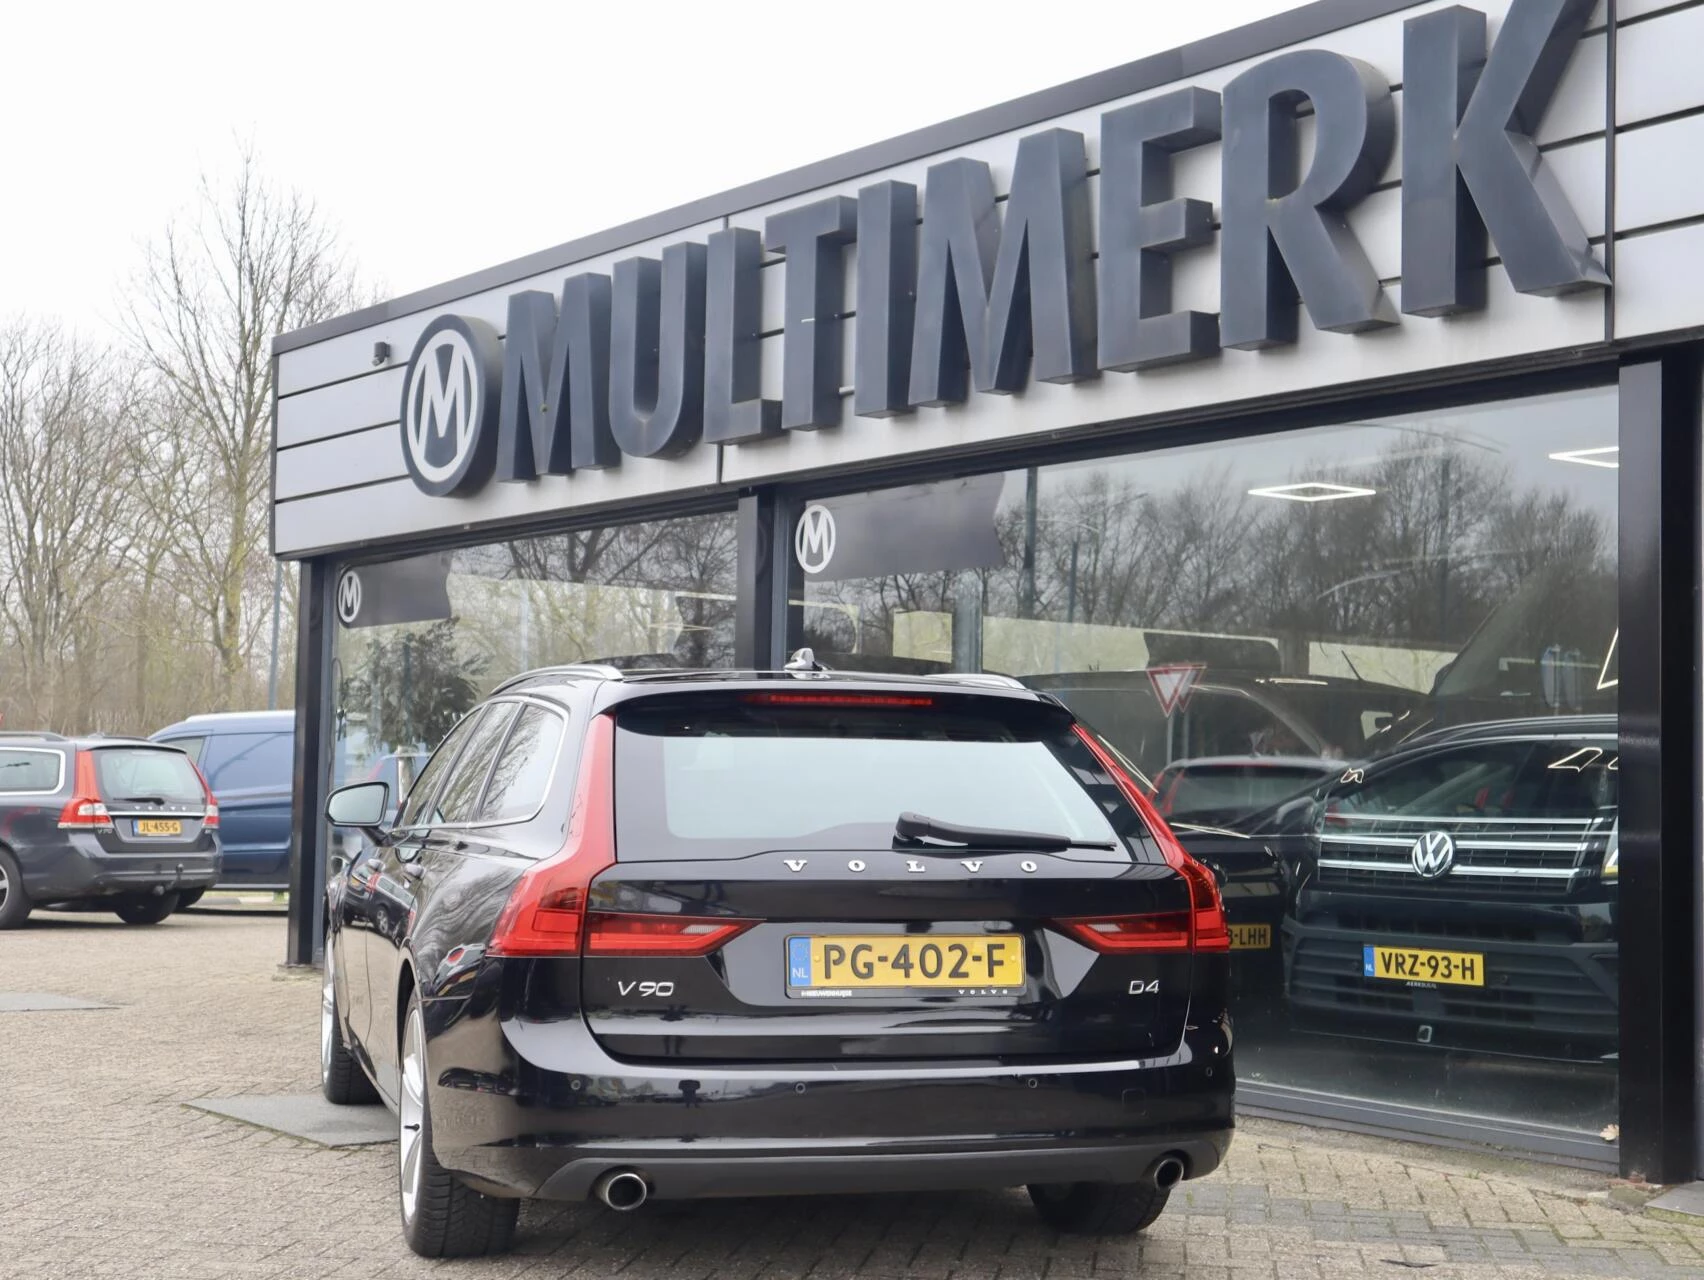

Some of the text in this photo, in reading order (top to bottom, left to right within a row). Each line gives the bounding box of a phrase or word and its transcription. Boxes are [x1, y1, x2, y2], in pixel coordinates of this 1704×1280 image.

[496, 0, 1612, 480] MULTIMERK
[411, 330, 474, 478] M
[797, 507, 834, 571] M
[339, 572, 360, 620] M
[783, 859, 1039, 873] VOLVO
[792, 967, 809, 979] NL
[823, 943, 1006, 980] PG-402-F
[1380, 951, 1476, 981] VRZ-93-H
[617, 980, 675, 997] V90
[1128, 979, 1160, 995] D4
